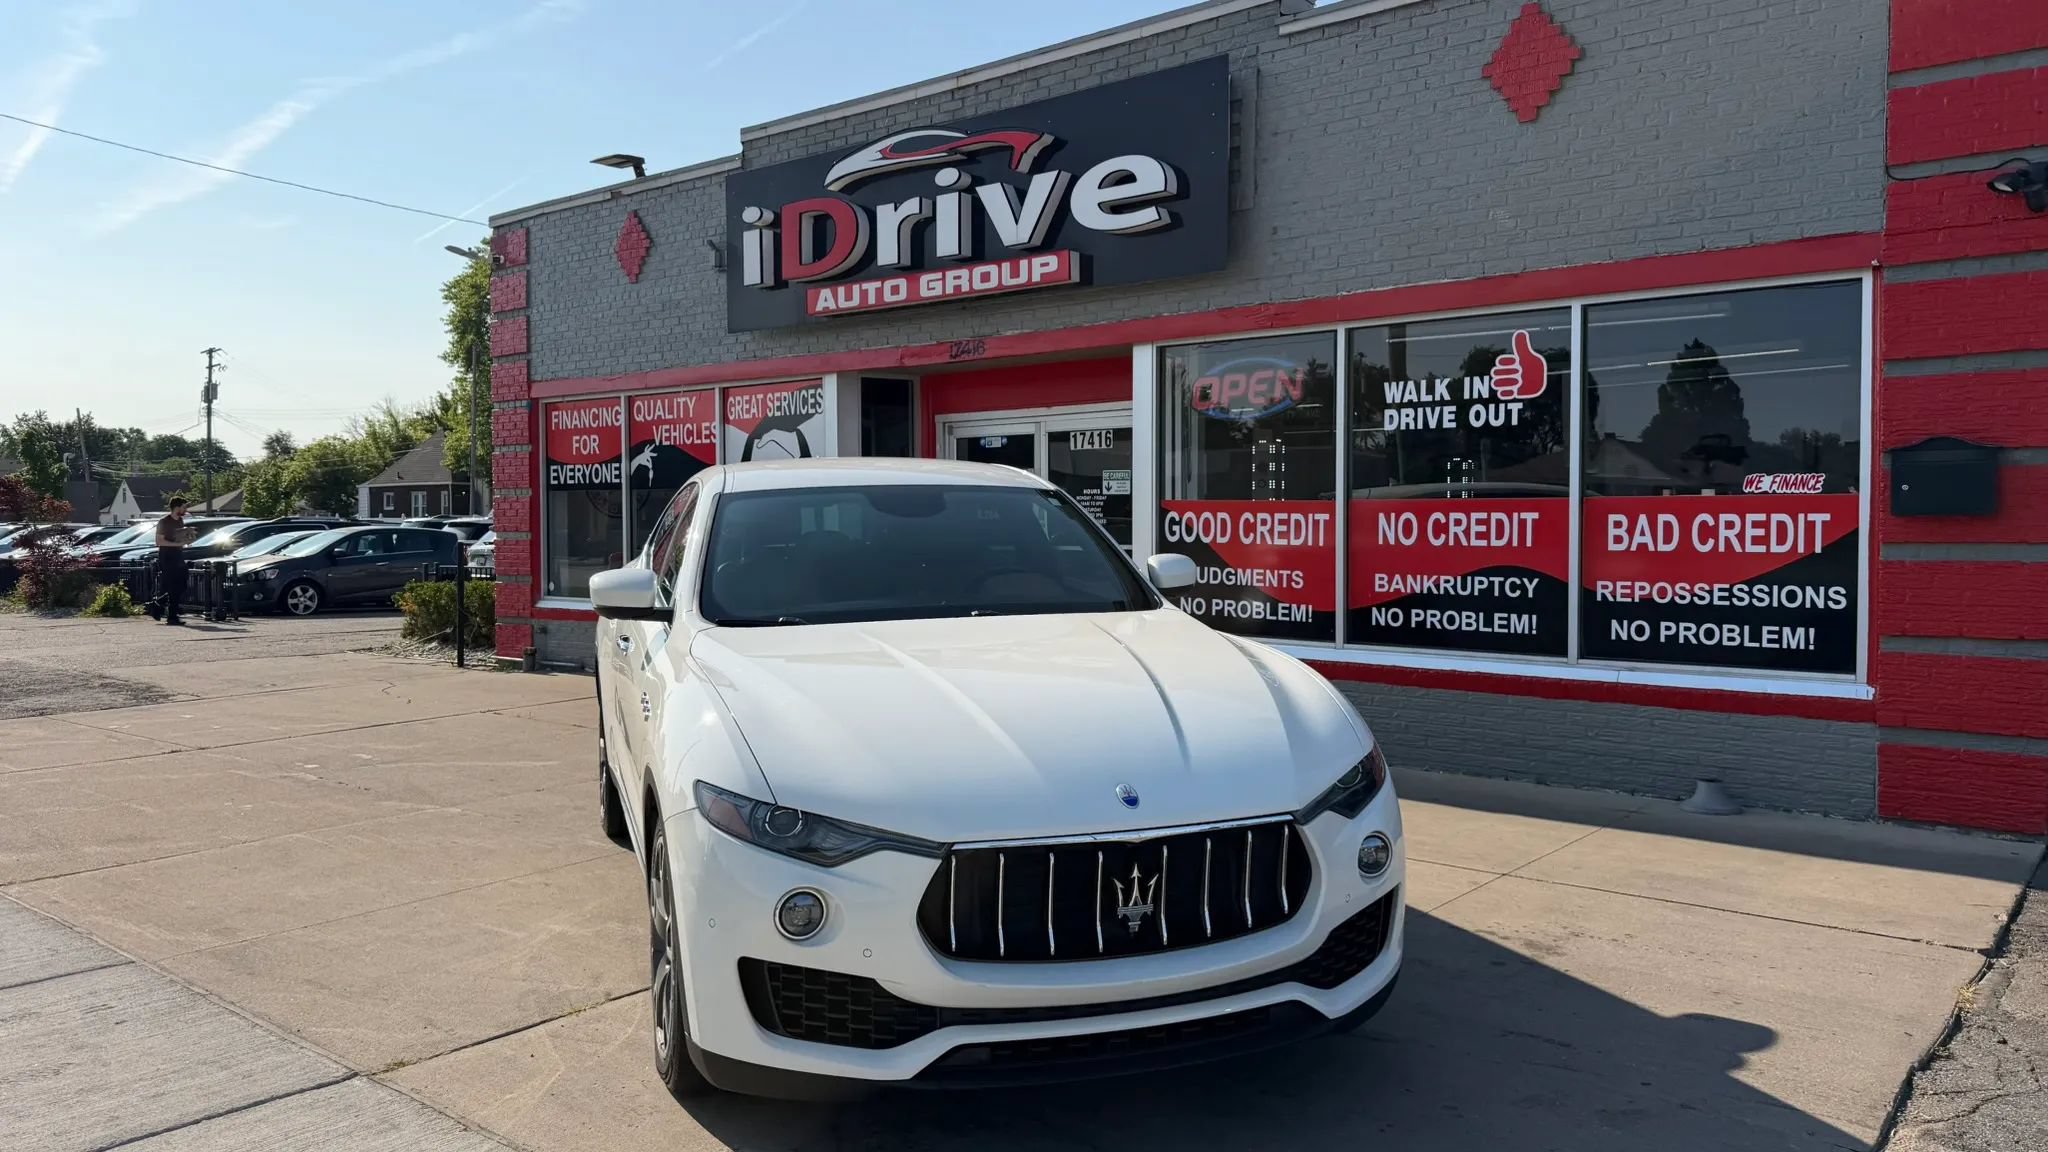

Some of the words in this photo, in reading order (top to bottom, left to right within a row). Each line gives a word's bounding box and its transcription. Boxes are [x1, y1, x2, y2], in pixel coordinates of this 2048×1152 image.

[741, 153, 1178, 288] iDrive
[815, 278, 907, 312] AUTO
[919, 254, 1059, 297] GROUP
[1192, 367, 1305, 411] OPEN
[1384, 377, 1451, 405] WALK
[1463, 375, 1490, 399] IN
[551, 405, 621, 431] FINANCING
[633, 396, 696, 422] QUALITY
[727, 395, 763, 421] GREAT
[766, 388, 824, 417] SERVICES
[1383, 405, 1457, 431] DRIVE
[1469, 402, 1524, 428] OUT
[572, 434, 600, 455] FOR
[653, 421, 717, 446] VEHICLES
[1071, 430, 1112, 449] 17416
[1743, 473, 1765, 493] WE
[1768, 472, 1825, 494] FINANCE
[1164, 511, 1232, 544] GOOD
[1239, 512, 1330, 547] CREDIT
[1378, 512, 1418, 546] NO
[1427, 512, 1539, 547] CREDIT
[1607, 513, 1680, 552] BAD
[1691, 512, 1831, 554] CREDIT
[1195, 566, 1304, 589] UDGMENTS
[1374, 573, 1540, 598] BANKRUPTCY
[1180, 596, 1206, 615] NO
[1211, 598, 1313, 623] PROBLEM!
[1596, 580, 1847, 610] REPOSSESSIONS
[1371, 607, 1405, 628] NO
[1410, 608, 1538, 635] PROBLEM!
[1610, 619, 1651, 642] NO
[1659, 620, 1816, 650] PROBLEM!
